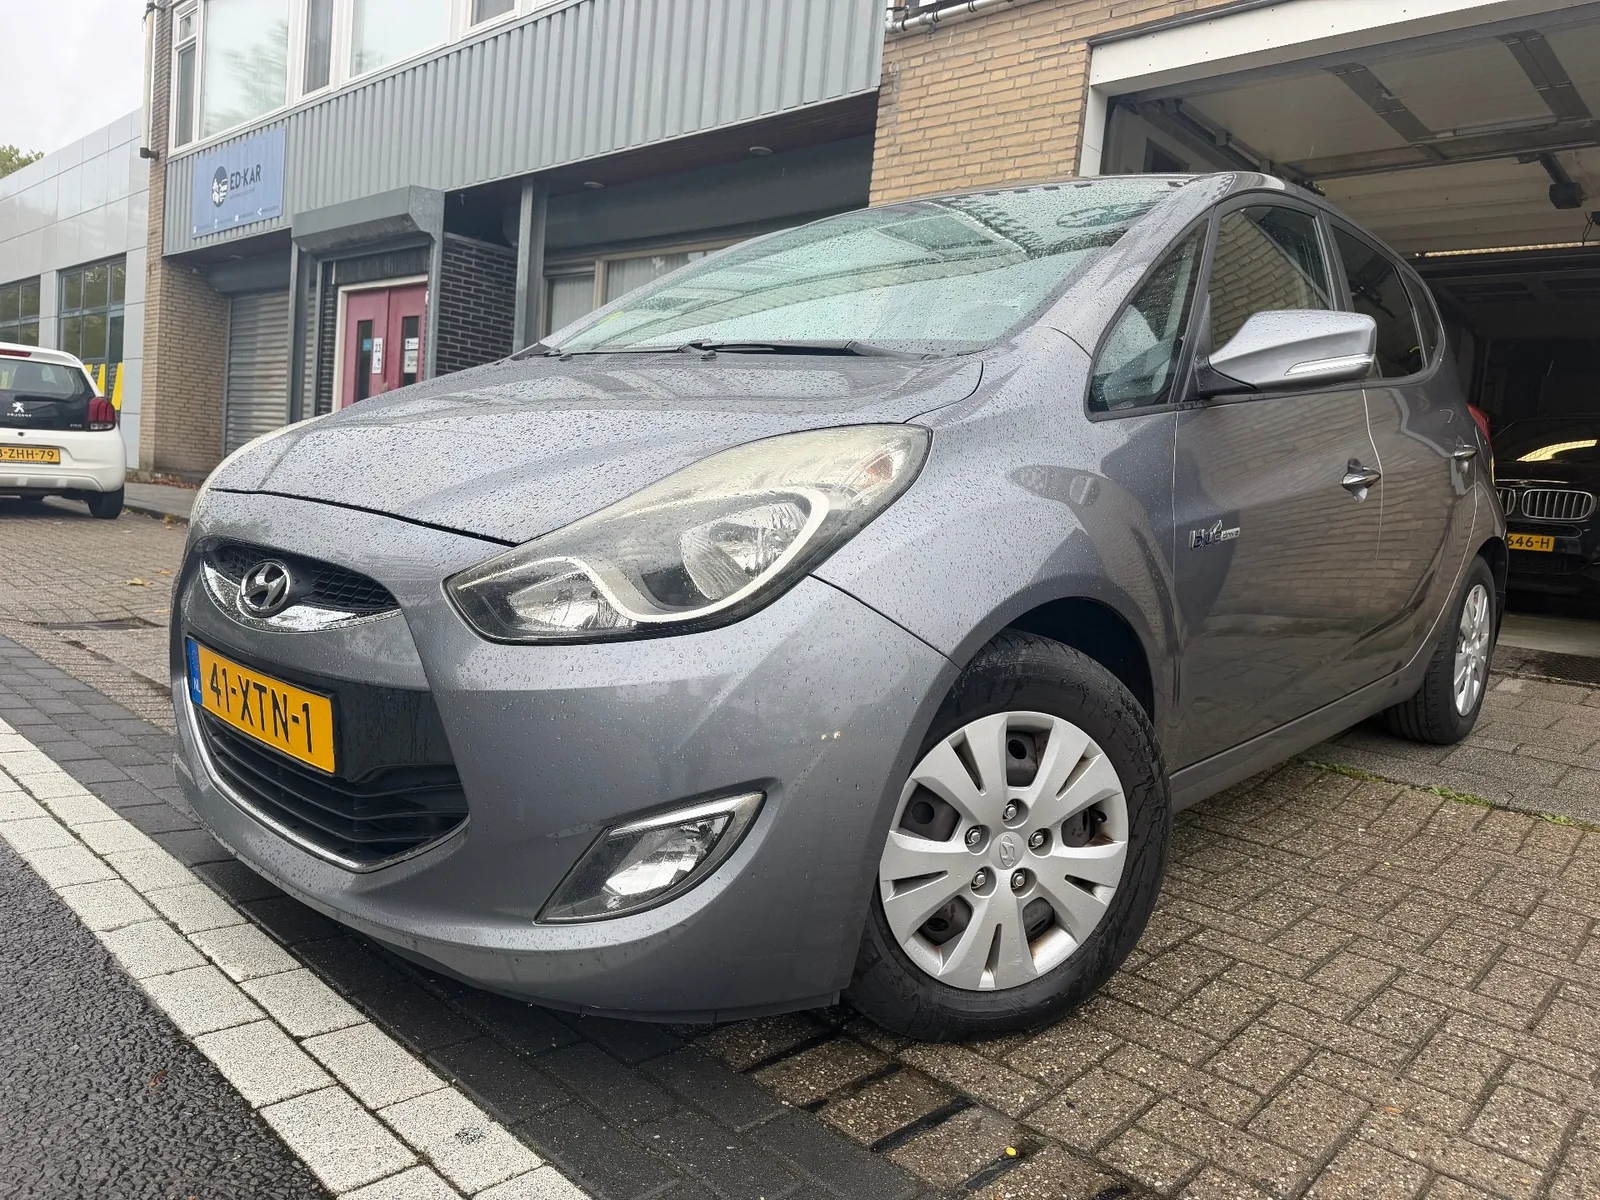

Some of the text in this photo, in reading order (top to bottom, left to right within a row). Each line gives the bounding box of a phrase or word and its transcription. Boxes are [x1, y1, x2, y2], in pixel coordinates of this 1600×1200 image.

[230, 164, 261, 190] ED-KAR
[193, 678, 201, 693] NL
[210, 662, 312, 753] 41-XTN-1
